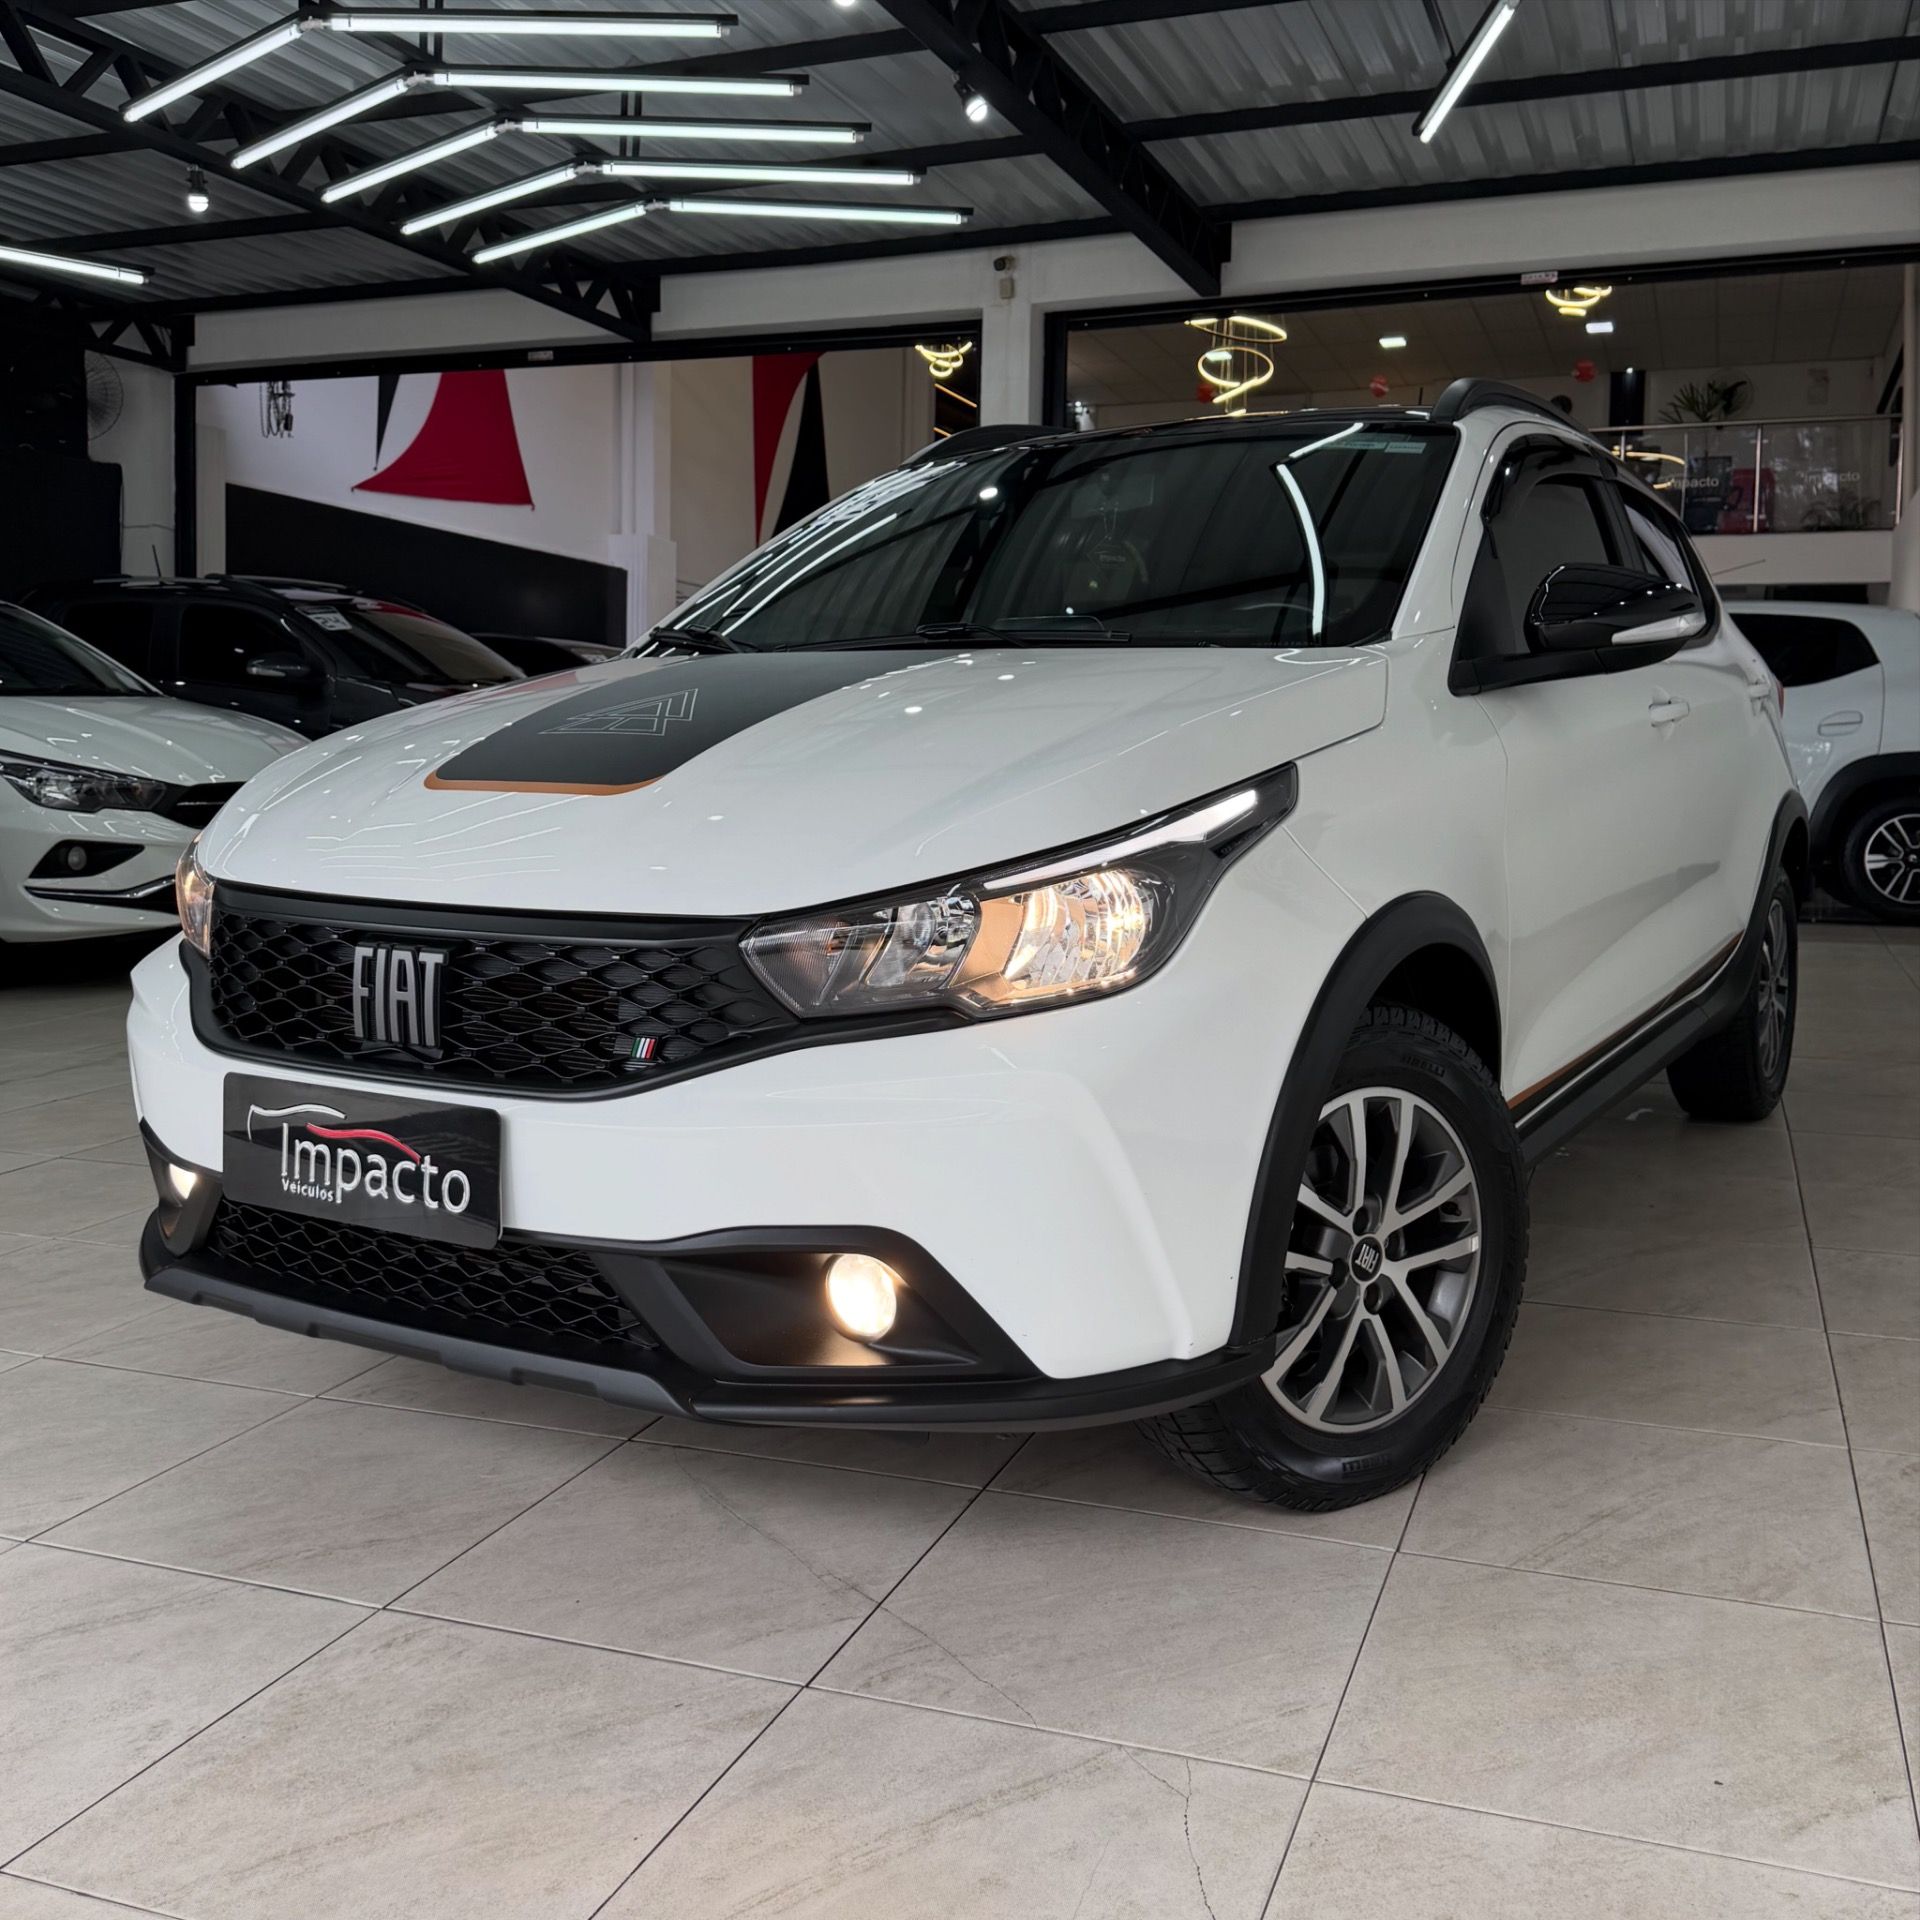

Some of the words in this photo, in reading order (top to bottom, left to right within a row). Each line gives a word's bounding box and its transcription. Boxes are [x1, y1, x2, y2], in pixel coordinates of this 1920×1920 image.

[353, 946, 444, 1047] FIAT
[281, 1122, 471, 1213] Impacto
[1354, 1243, 1380, 1273] FIAT
